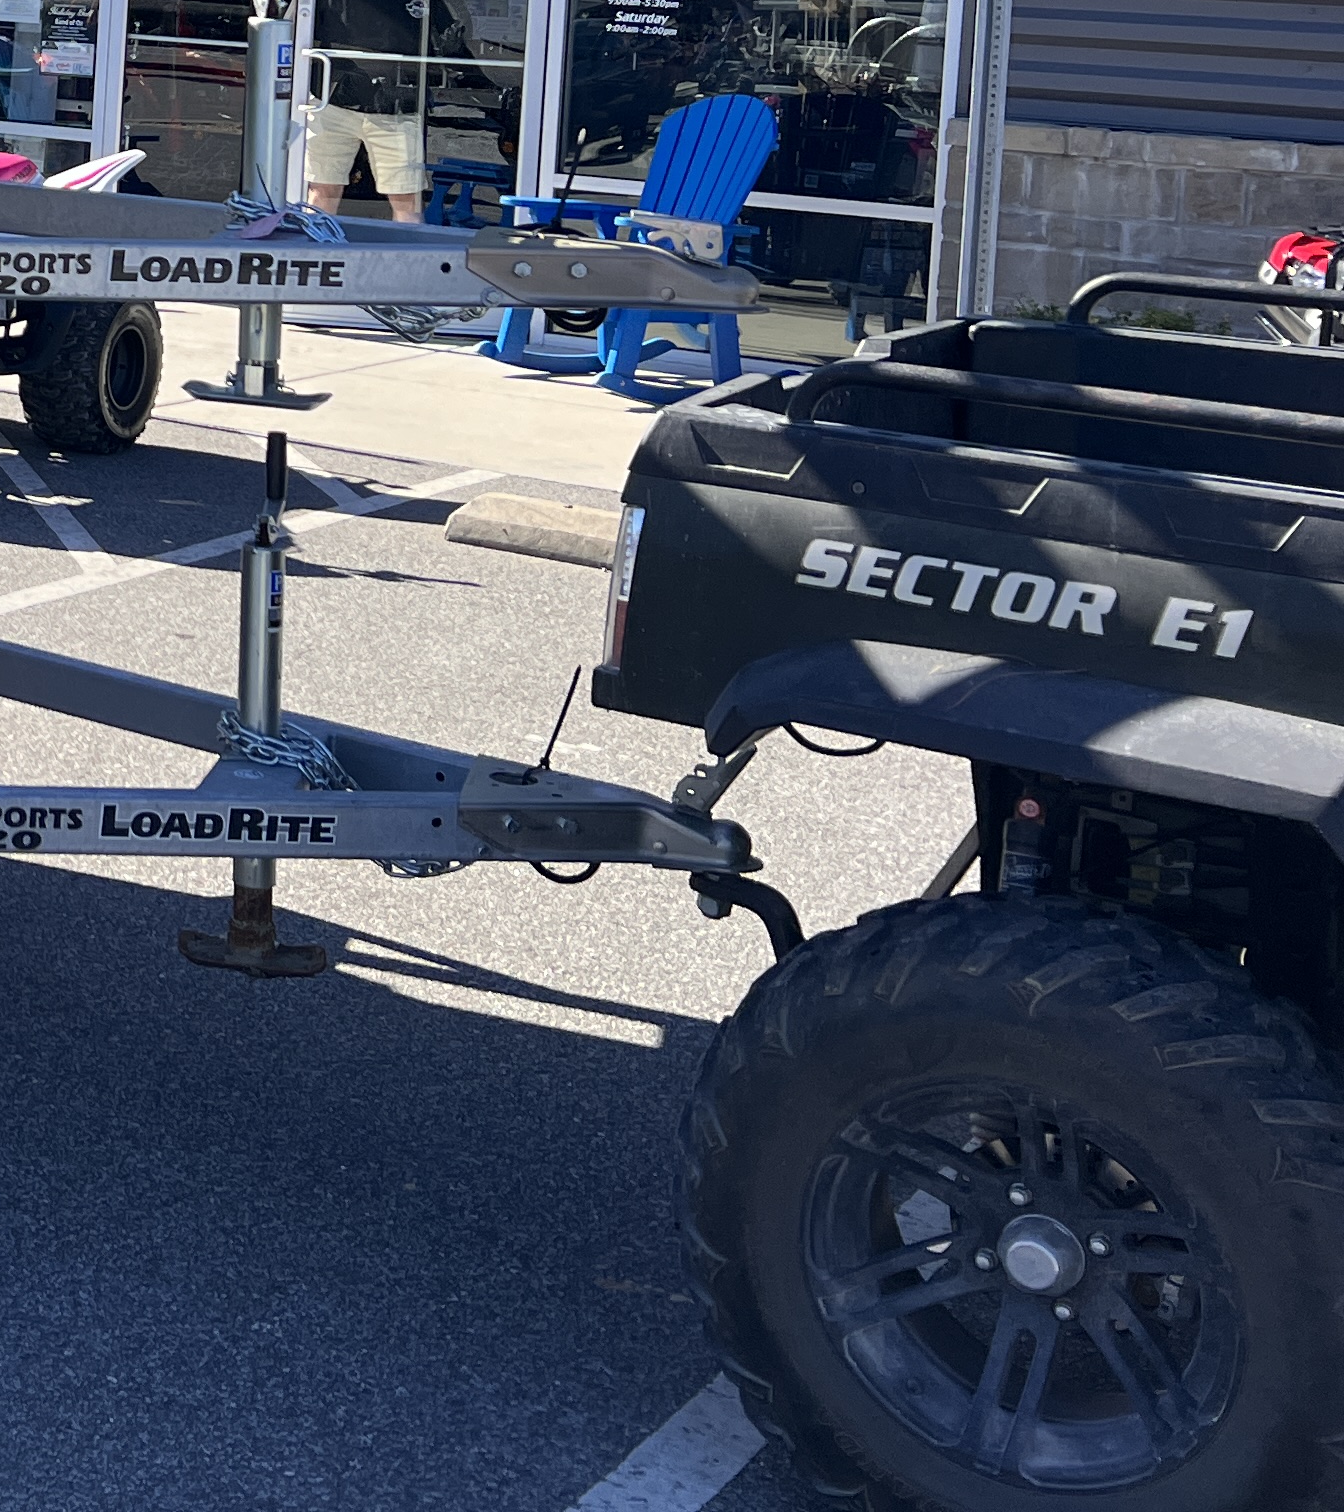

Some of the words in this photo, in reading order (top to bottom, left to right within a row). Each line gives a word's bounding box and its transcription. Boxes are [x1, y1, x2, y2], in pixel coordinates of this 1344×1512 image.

[614, 10, 670, 26] Saturday
[796, 537, 1118, 636] SECTOR
[1151, 596, 1255, 660] E1
